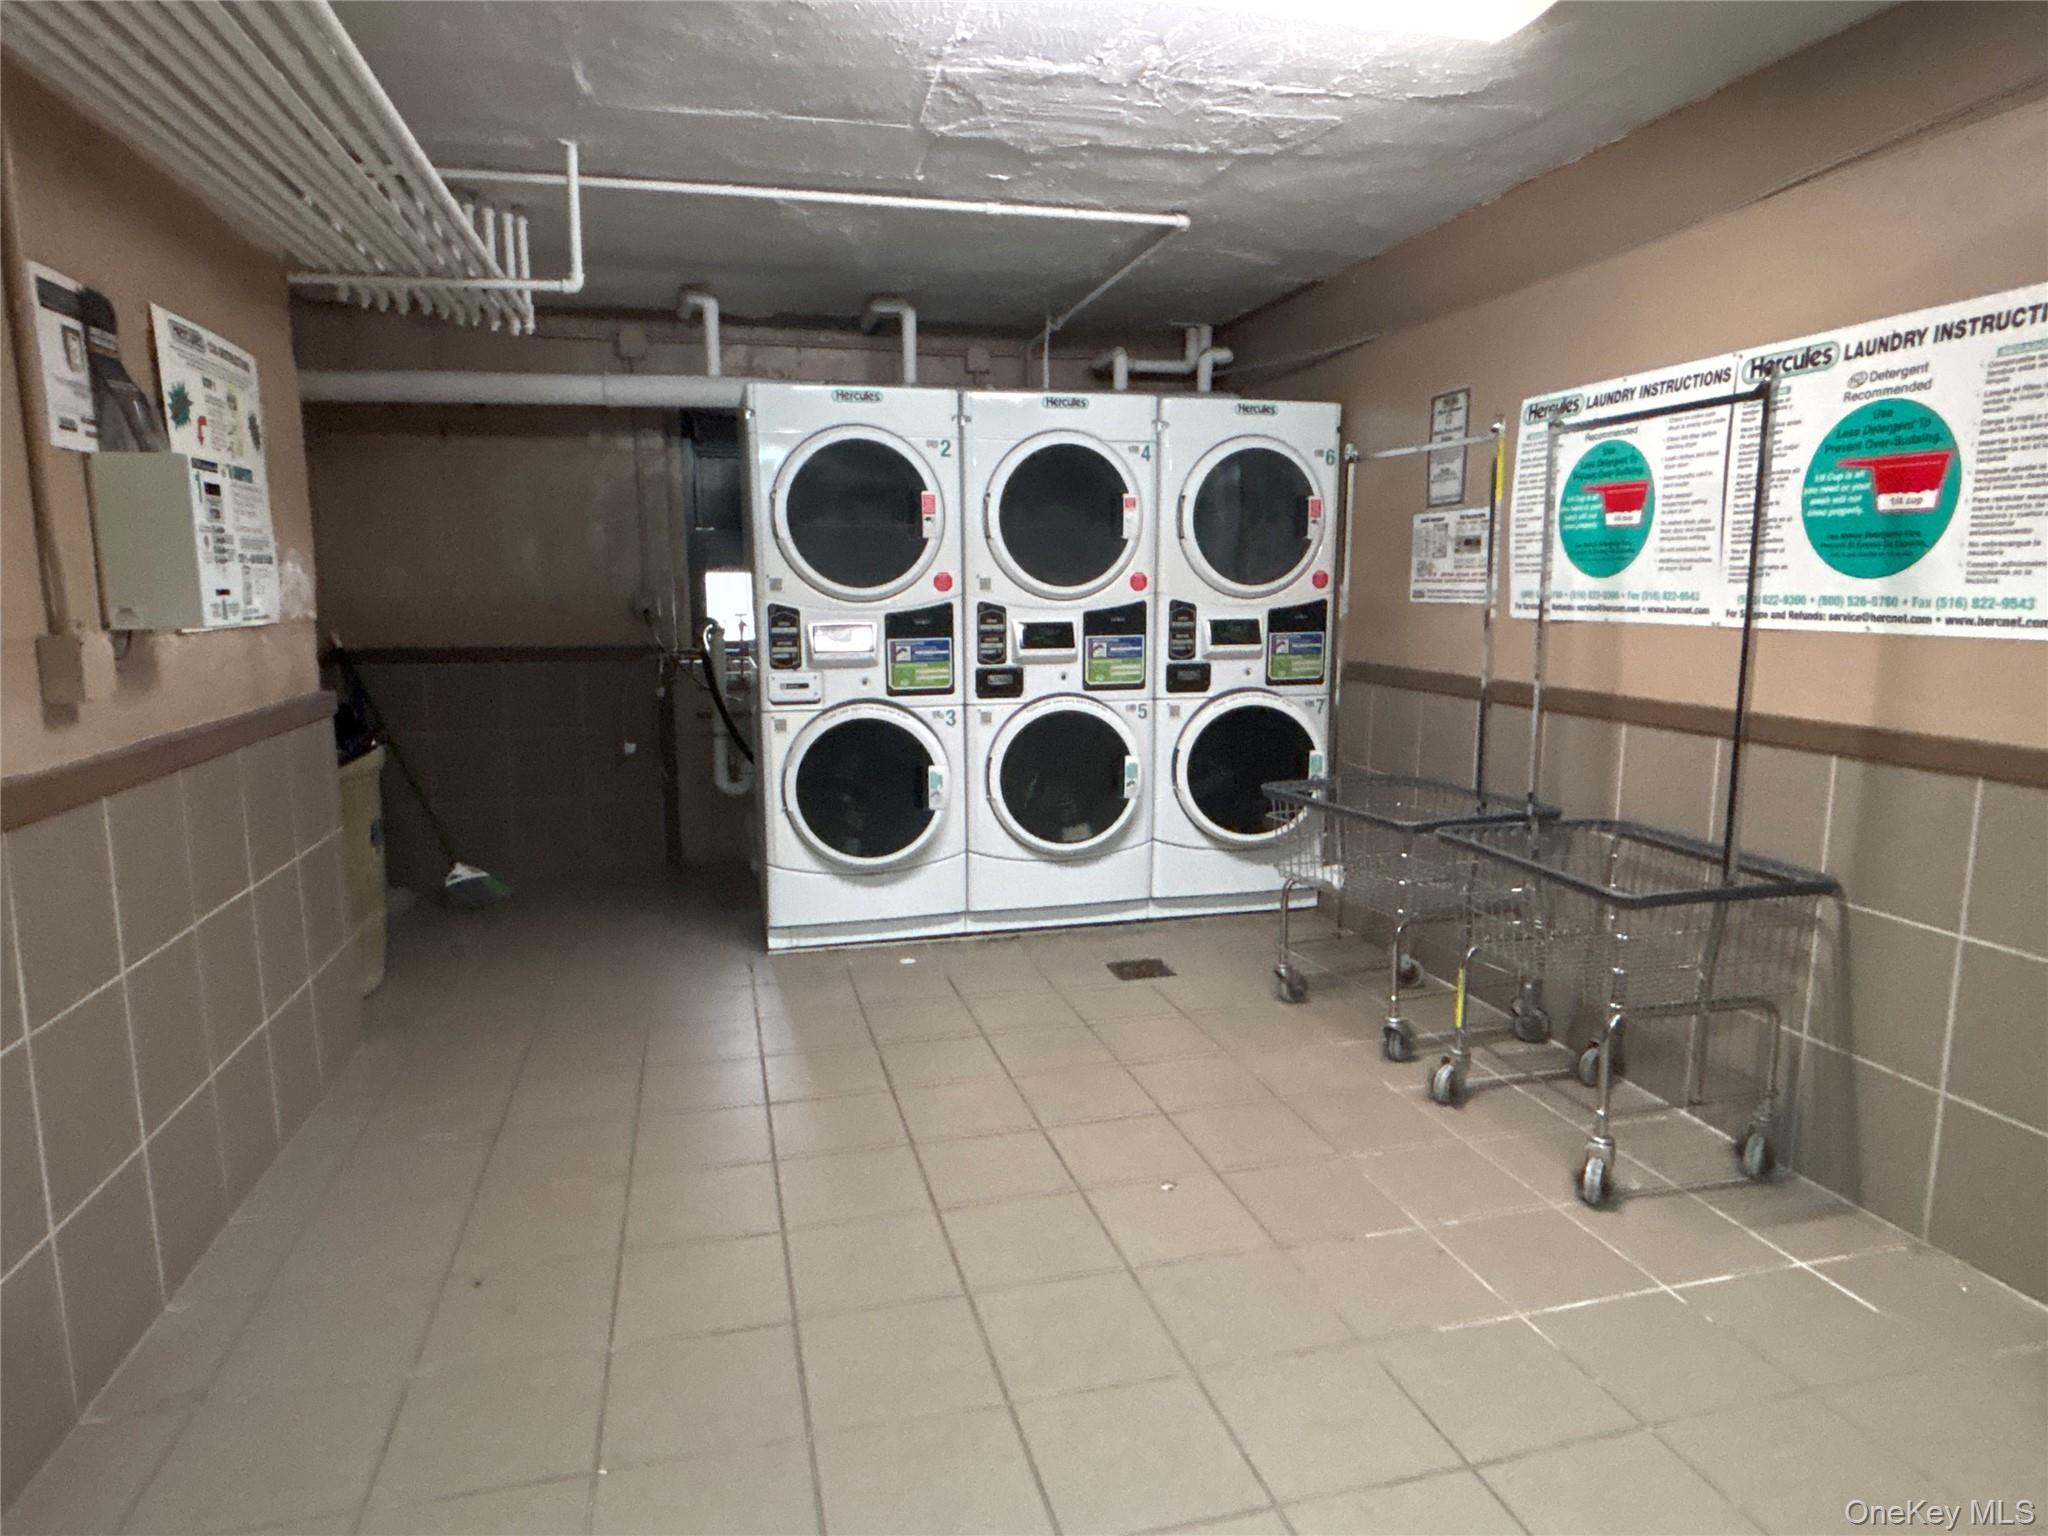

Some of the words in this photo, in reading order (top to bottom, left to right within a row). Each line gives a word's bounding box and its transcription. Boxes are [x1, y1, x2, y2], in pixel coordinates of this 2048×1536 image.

[1749, 346, 1832, 379] Hercules
[1844, 327, 1928, 361] LAUNDRY
[1933, 303, 2048, 344] INSTRUCTI
[1869, 362, 1929, 383] Detergent
[836, 389, 880, 402] Hercules
[1528, 398, 1580, 421] Hercules
[1586, 386, 1635, 410] LAUNDRY
[1639, 367, 1732, 399] INSTRUCTIONS
[1843, 378, 1932, 402] Recommended
[1045, 397, 1087, 409] Hercules
[1238, 404, 1277, 416] Hercules
[1863, 420, 1915, 435] Detergent
[940, 440, 951, 457] 2
[1141, 445, 1151, 461] 4
[1325, 449, 1336, 466] 6
[1912, 597, 1931, 609] Fax
[1936, 597, 1968, 611] (516)
[1726, 609, 1737, 619] For
[1137, 703, 1148, 720] 5
[1316, 698, 1325, 714] 7
[945, 709, 957, 727] 3
